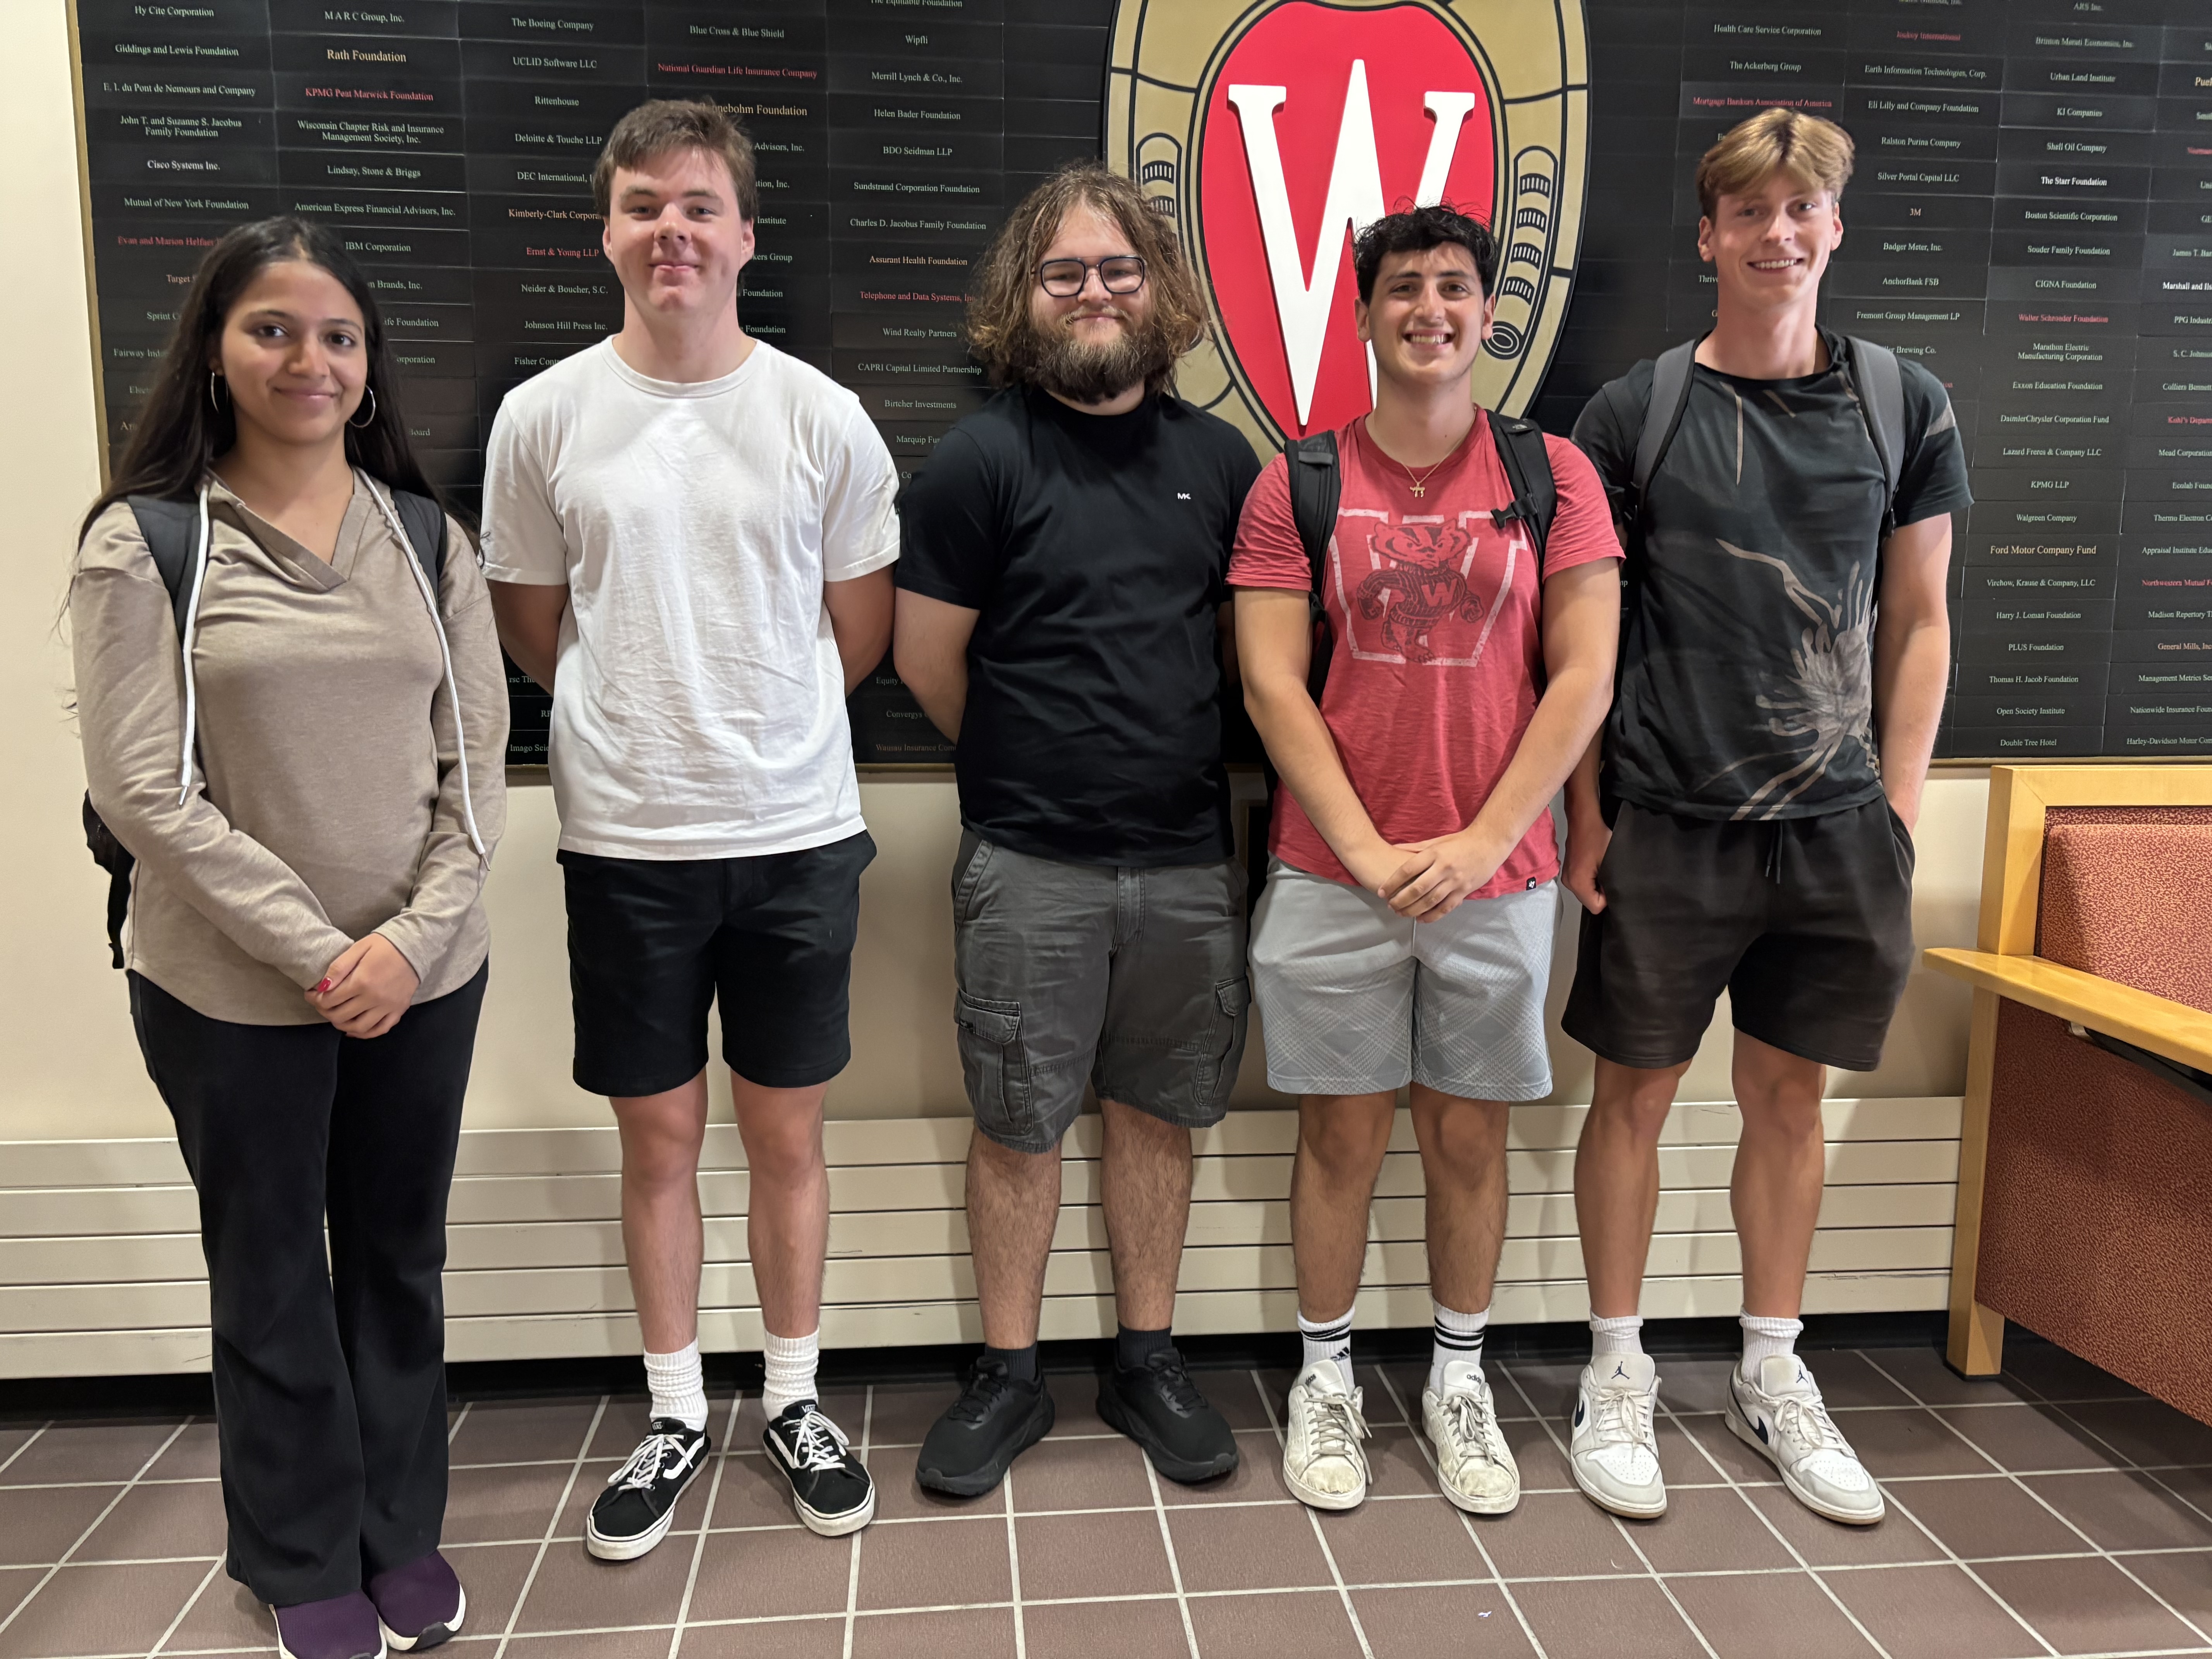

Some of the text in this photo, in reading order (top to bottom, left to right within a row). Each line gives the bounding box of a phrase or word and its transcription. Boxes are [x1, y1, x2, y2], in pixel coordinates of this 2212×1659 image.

[135, 5, 214, 17] Hy Cite Corporation
[511, 17, 593, 31] The Boeing Company
[690, 25, 784, 38] Blue Cross & Blue Shield
[905, 35, 928, 46] Wipfli
[115, 44, 239, 56] Giddings and Lewis Foundation
[327, 49, 406, 62] Rath Foundation
[513, 57, 597, 68] UCLID Software LLC
[1730, 61, 1802, 72] The Ackerberg Group
[535, 96, 579, 106] Rittenhouse
[1868, 101, 1979, 113] Eli Lilly and Company Foundation
[874, 109, 960, 120] Helen Bader Foundation
[120, 115, 242, 127] John T. and Suzanne S. Jacobus
[145, 127, 218, 137] Family Foundation
[297, 120, 444, 134] Wisconsin Chapter Risk and Insurance
[322, 131, 421, 144] Management Society, Inc.
[515, 134, 602, 144] Deloitte & Touche LLP
[1881, 137, 1961, 149] Ralston Purina Company
[904, 147, 934, 155] Seidman
[937, 148, 953, 156] LLP
[2047, 143, 2107, 153] Shell Oil Company
[147, 160, 220, 171] Cisco Systems Inc.
[327, 165, 421, 179] Lindsay, Stone & Briggs
[2041, 176, 2107, 186] The Starr Foundation
[854, 182, 980, 193] Sundstrand Corporation Foundation
[124, 198, 249, 210] Mutual of New York Foundation
[295, 203, 455, 216] American Express Financial Advisors, Inc.
[1910, 208, 1921, 216] 3M
[850, 218, 878, 227] Charles
[890, 219, 918, 228] Jacobus
[919, 220, 945, 230] Family
[947, 221, 986, 230] Foundation
[345, 242, 411, 252] IBM Corporation
[1228, 58, 1475, 426] W
[526, 247, 599, 258] Ernst & Young LLP
[2051, 246, 2073, 256] Family
[2075, 246, 2110, 255] Foundation
[869, 256, 967, 265] Assurant Health Foundation
[166, 274, 190, 284] Target
[1882, 277, 1939, 286] AnchorBank FSB
[524, 321, 555, 329] Johnson
[557, 321, 570, 330] Hill
[594, 322, 608, 330] Inc.
[904, 328, 926, 338] Realty
[929, 329, 957, 337] Partners
[886, 364, 911, 373] Capital
[913, 364, 941, 373] Limited
[943, 365, 982, 375] Partnership
[915, 400, 957, 409] Investments
[2016, 514, 2077, 523] Walgreen Company
[1990, 545, 2096, 556] Ford Motor Company Fund
[1996, 611, 2014, 620] Harry
[876, 677, 897, 686] Equity
[886, 710, 923, 719] Convergys
[1996, 708, 2013, 716] Open
[2015, 708, 2038, 716] Society
[510, 744, 533, 753] Imago
